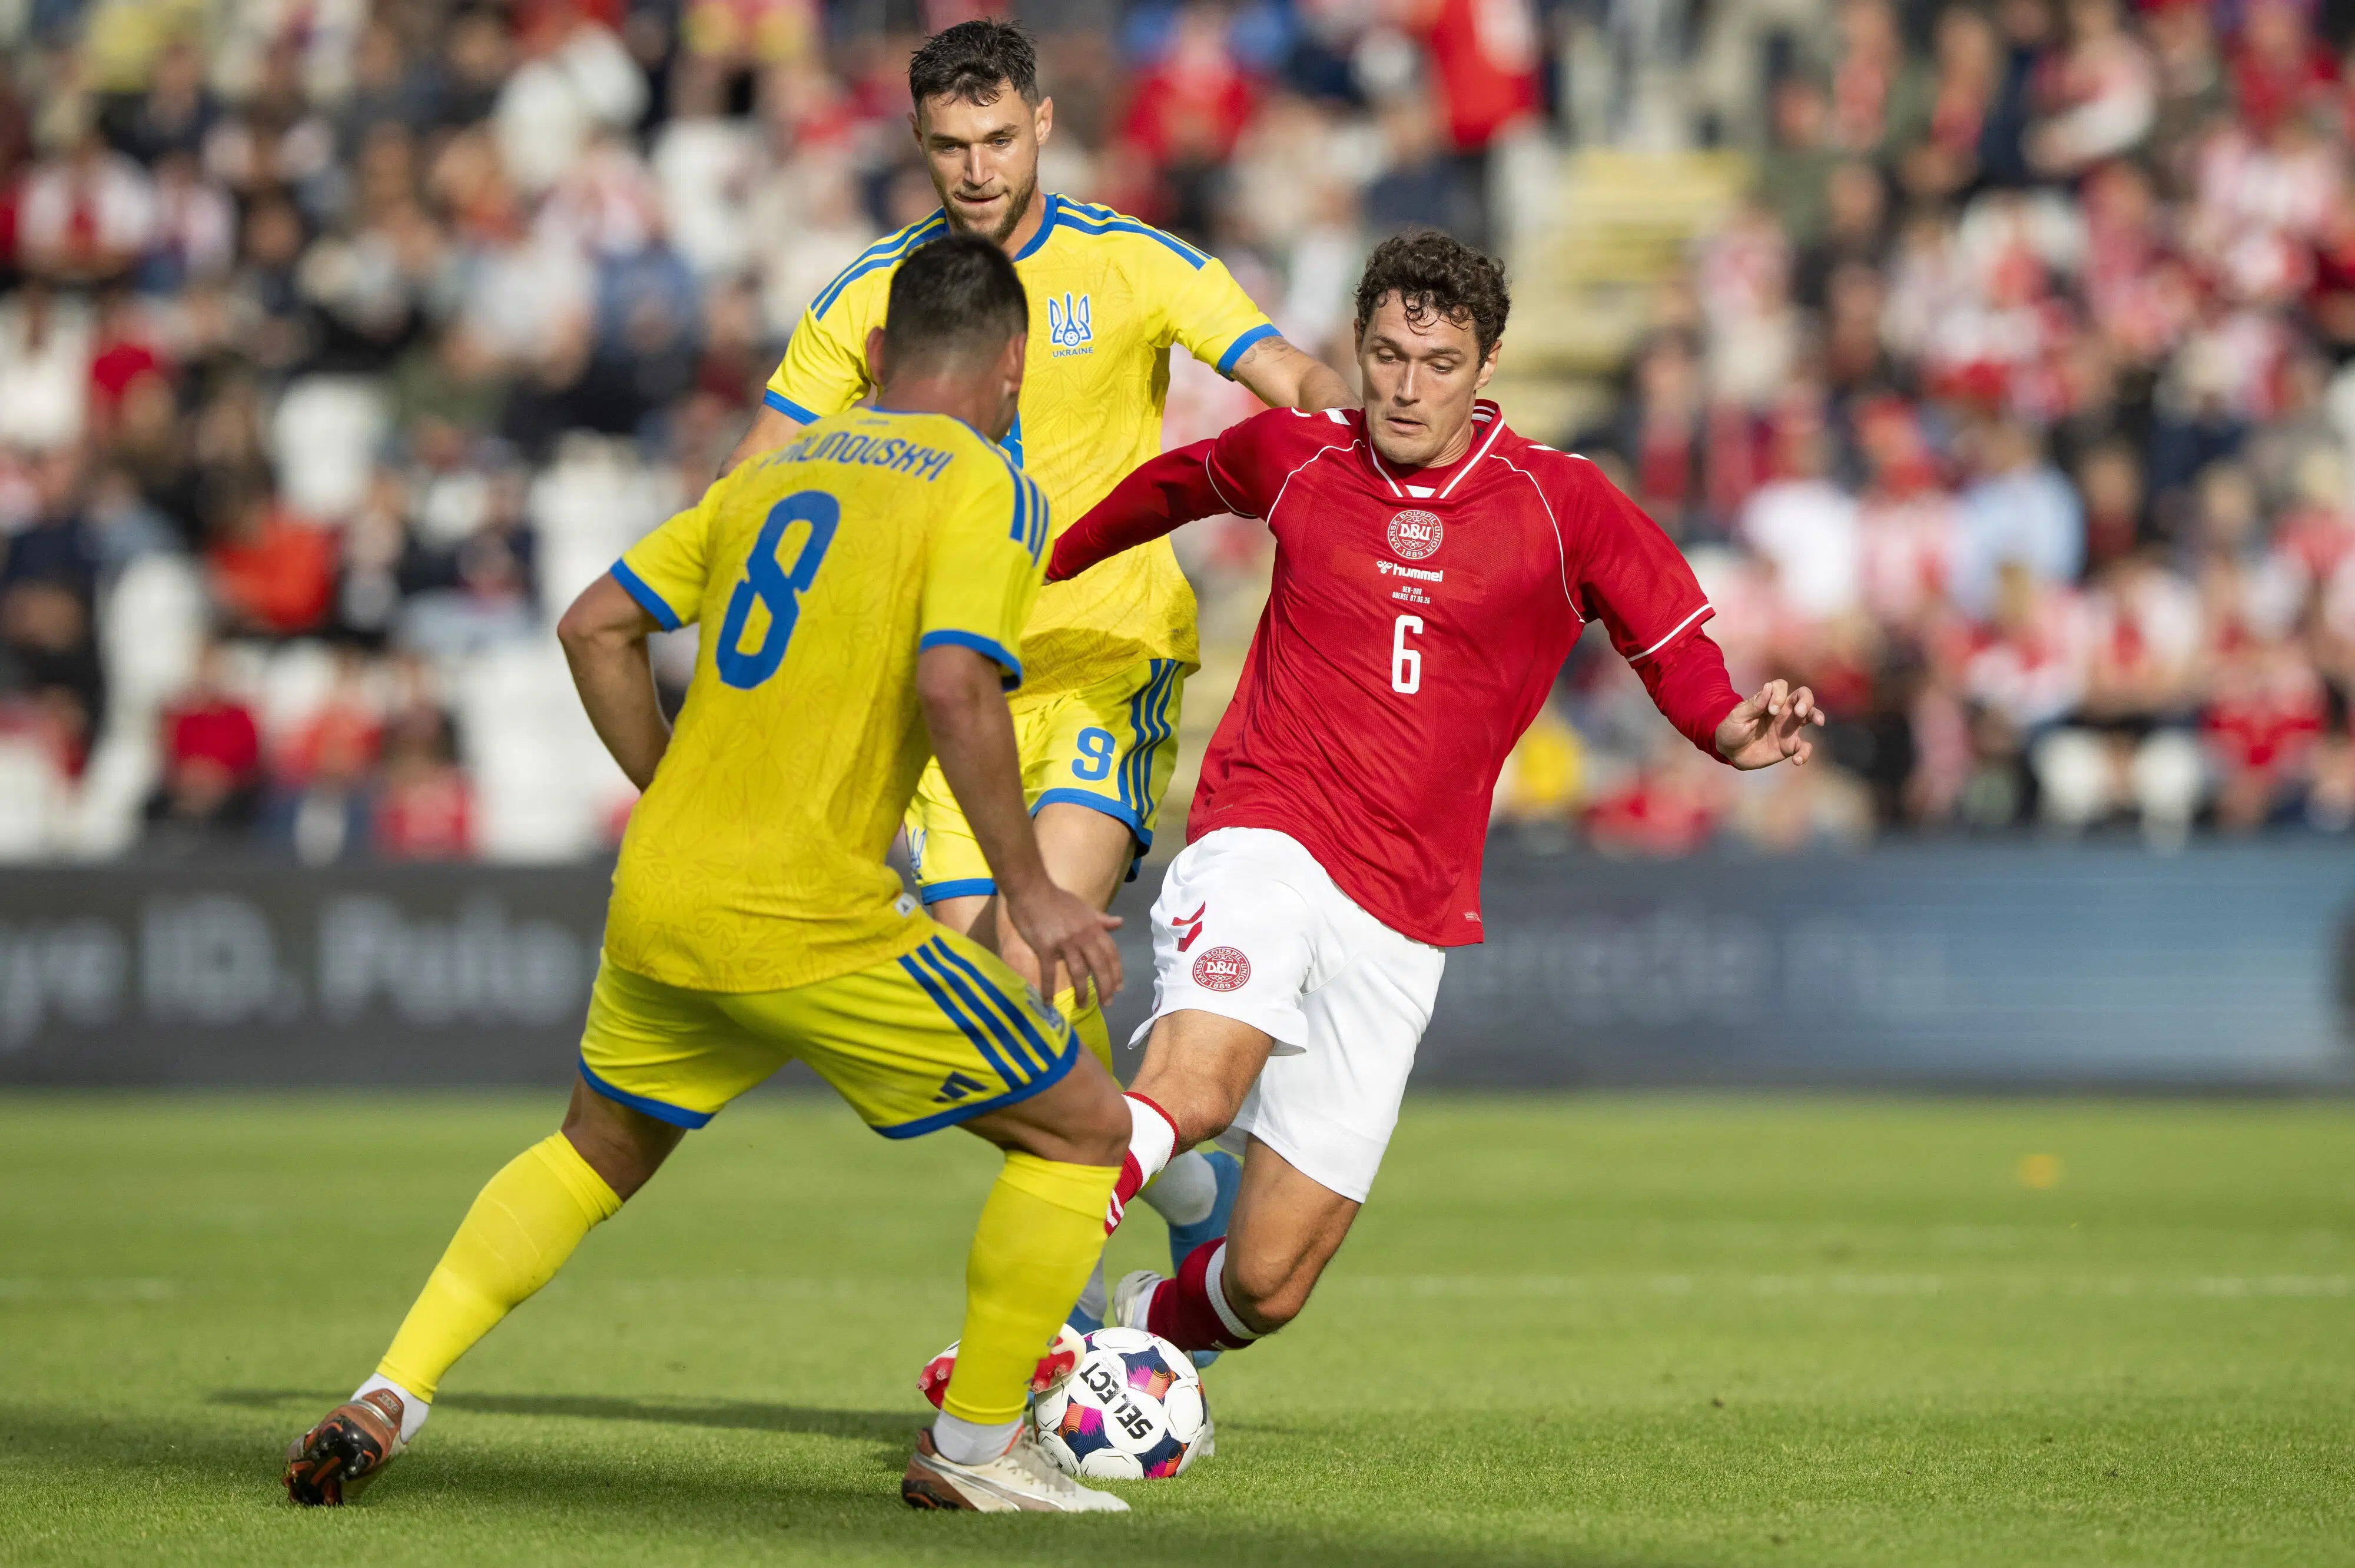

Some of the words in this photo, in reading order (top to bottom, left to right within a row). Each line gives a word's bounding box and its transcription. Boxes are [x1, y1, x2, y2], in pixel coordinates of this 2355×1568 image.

[1053, 347, 1093, 358] UKRAINE
[1389, 519, 1401, 549] DANSK
[1401, 549, 1423, 557] 1889
[1398, 523, 1431, 541] DBU
[1393, 563, 1444, 582] hummel
[715, 490, 840, 690] 8
[1392, 592, 1409, 600] ODENSE
[1402, 586, 1422, 595] DEN-UKR
[1391, 614, 1424, 695] 6
[1071, 726, 1116, 781] 9
[1196, 959, 1207, 983] DANSK
[1205, 961, 1238, 975] DBU
[1079, 1362, 1154, 1440] SELECT
